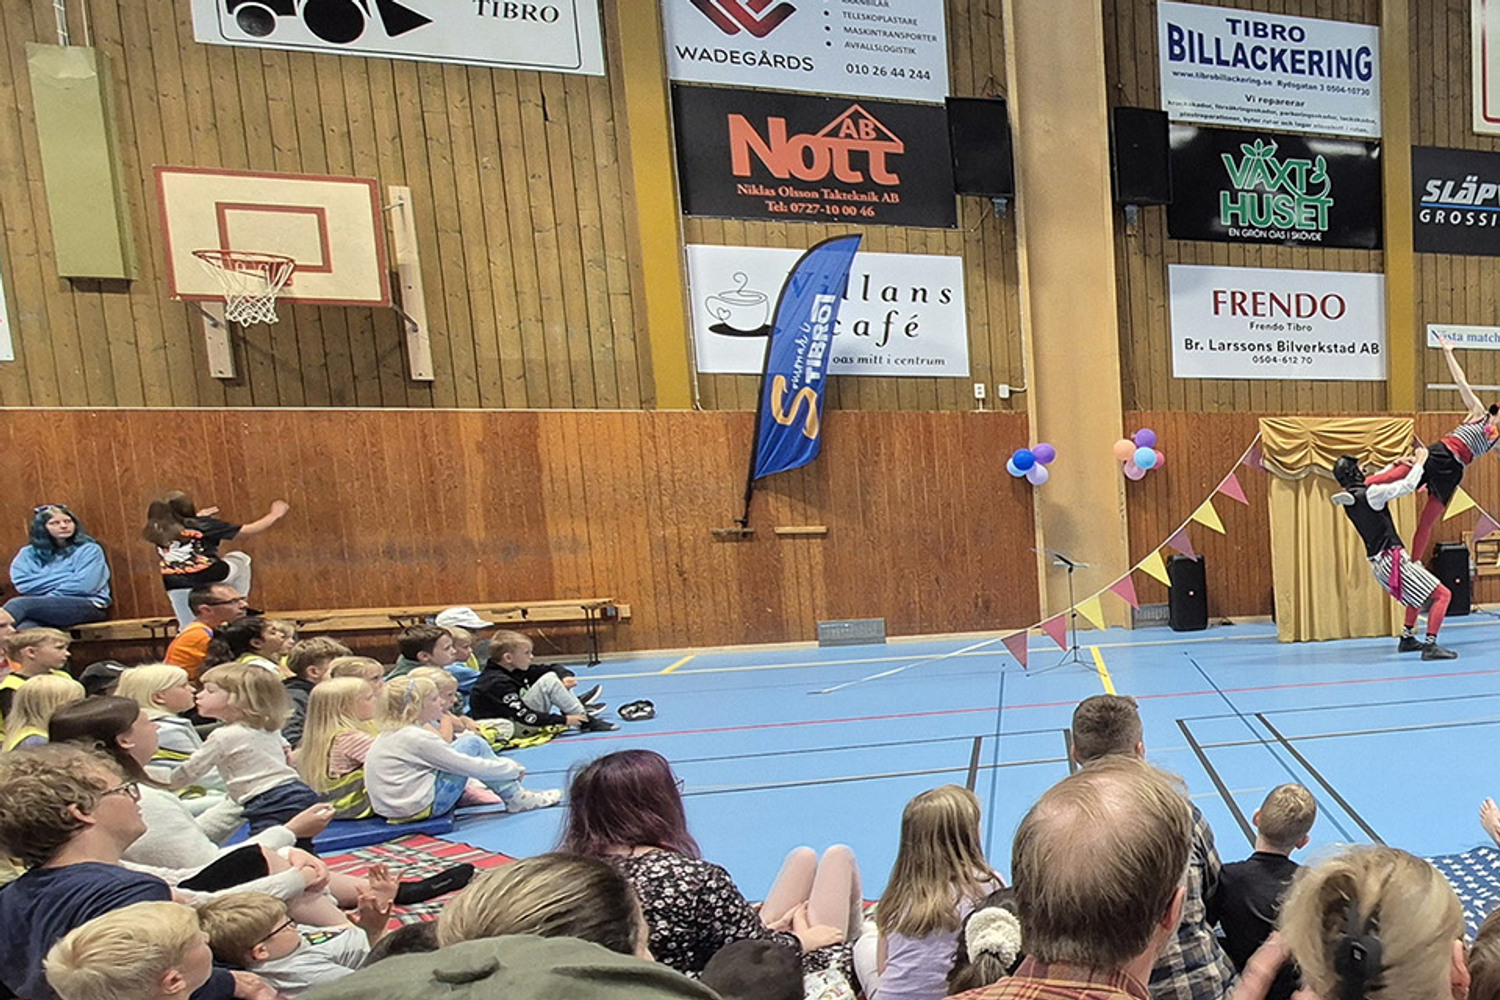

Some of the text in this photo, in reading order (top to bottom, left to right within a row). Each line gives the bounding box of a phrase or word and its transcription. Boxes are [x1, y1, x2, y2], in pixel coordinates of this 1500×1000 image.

[472, 0, 559, 23] TIBRO
[842, 11, 918, 26] TELESKOPLASTARE
[843, 27, 938, 41] MASKINTRANSPORTER
[1226, 18, 1305, 42] TIBRO
[844, 41, 917, 55] AVFALLSLOGISTIK
[1167, 22, 1373, 81] BILLACKERING
[675, 45, 814, 71] WADEGÅRDS
[846, 63, 931, 80] 010 26 44 244
[1171, 71, 1272, 86] www.tibrobillackering.se
[1244, 94, 1305, 107] Vi reparerar
[838, 118, 878, 140] AB
[727, 114, 904, 185] Nott
[1221, 139, 1313, 191] VÄXT
[737, 184, 900, 204] Niklas Olsson Takteknik AB
[765, 200, 875, 217] Tel: 0727-10 00 46
[1220, 191, 1334, 231] HUSET
[1228, 228, 1240, 237] EN
[1241, 228, 1267, 238] GRÖN
[1268, 230, 1286, 239] OAS
[1291, 230, 1322, 241] SKÖVDE
[1212, 290, 1346, 320] FRENDO
[831, 310, 920, 347] café
[1250, 322, 1313, 332] Frendo Tibro
[1467, 331, 1500, 343] match
[1184, 338, 1380, 354] Br. Larssons Bilverkstad AB
[832, 356, 854, 365] oas
[857, 354, 883, 365] mitt
[894, 355, 946, 366] centrum
[1252, 356, 1313, 365] 0504-612 70
